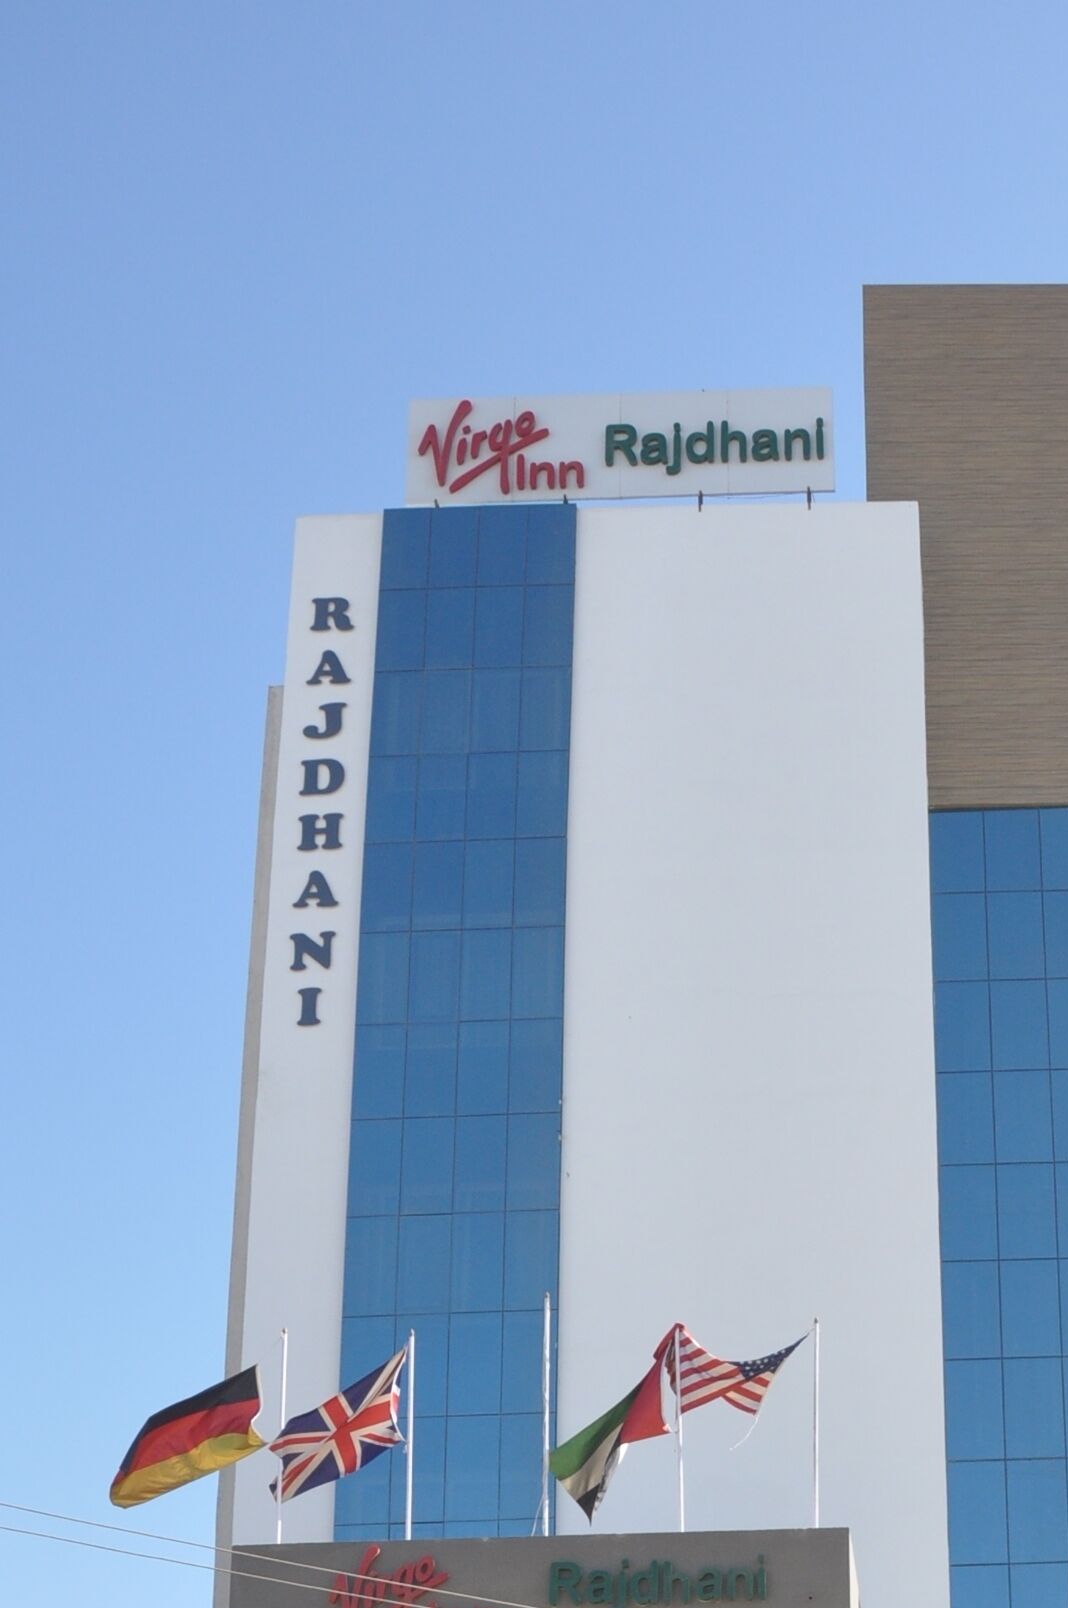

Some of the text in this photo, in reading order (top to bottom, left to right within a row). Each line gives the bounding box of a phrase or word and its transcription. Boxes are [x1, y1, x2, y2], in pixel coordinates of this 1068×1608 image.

[418, 399, 826, 494] Virgo Rajdhani
[516, 453, 585, 490] Inn
[289, 596, 355, 1027] RAJDHANI
